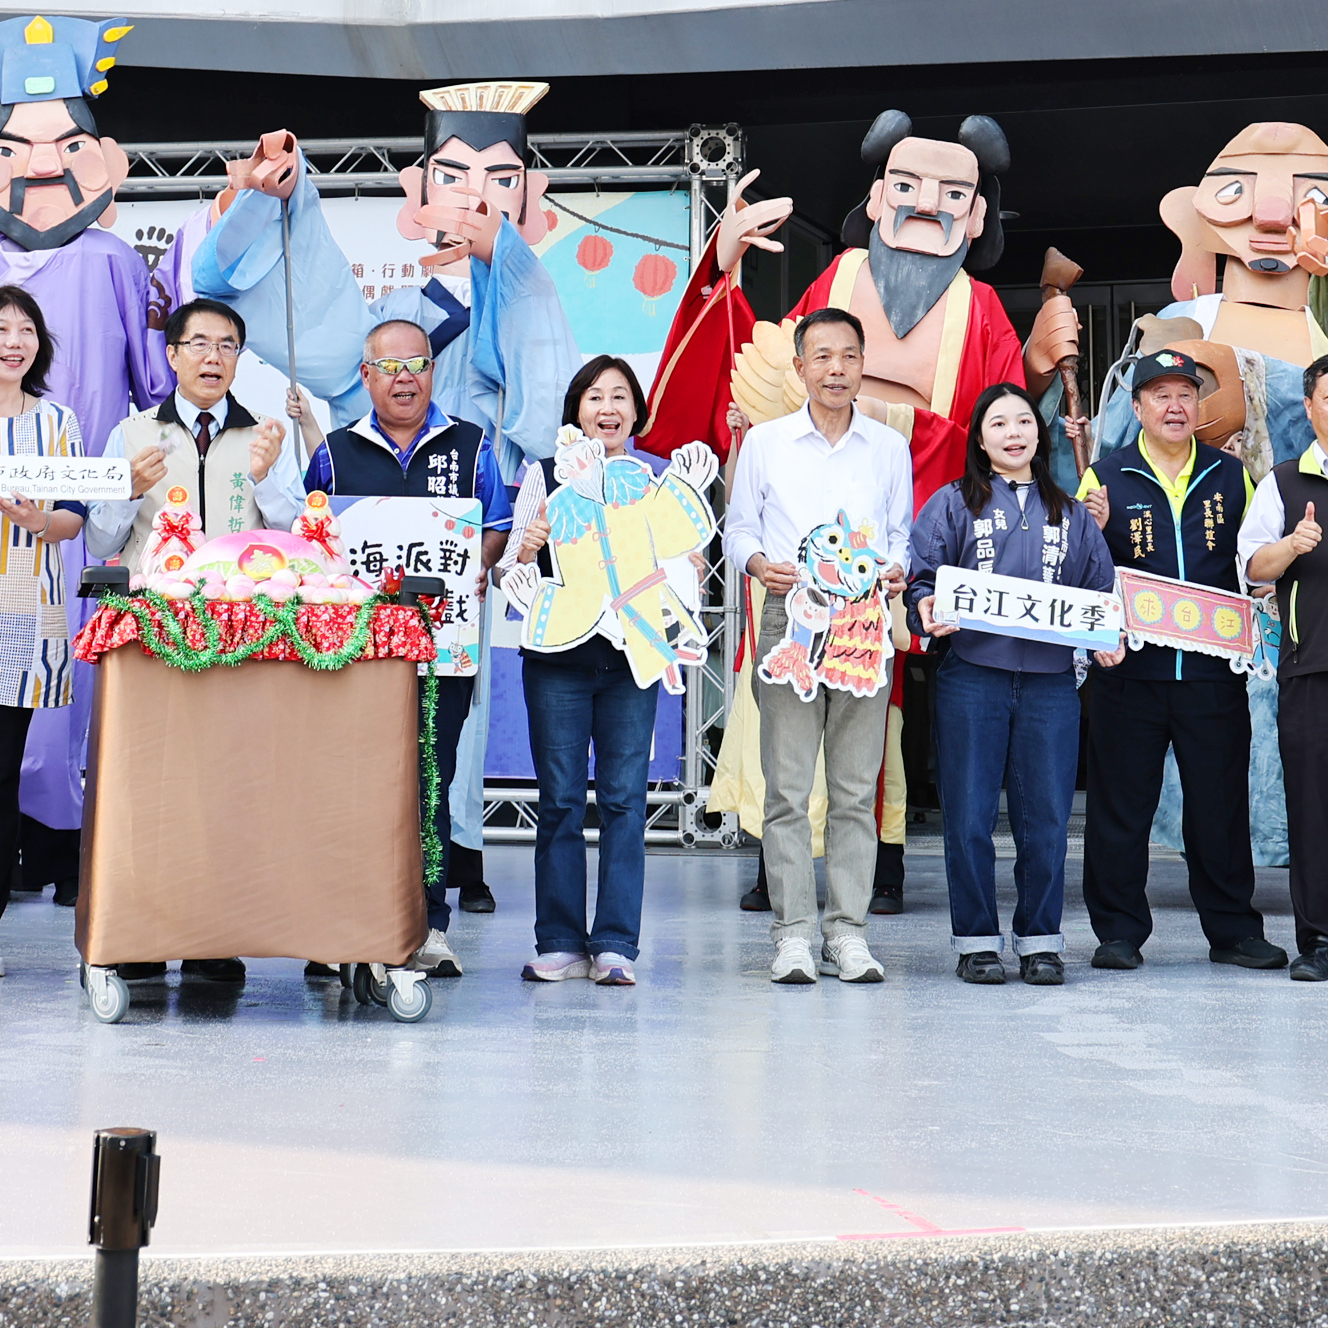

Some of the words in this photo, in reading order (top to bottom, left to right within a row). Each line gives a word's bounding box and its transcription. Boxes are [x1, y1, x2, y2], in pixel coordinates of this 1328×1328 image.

[60, 484, 76, 494] City
[79, 485, 126, 494] Government
[427, 454, 448, 498] 邱昭
[448, 448, 460, 498] 台南市議
[228, 472, 247, 533] 黃偉哲
[993, 508, 1008, 530] 女兒
[1213, 492, 1225, 524] 安南區
[1129, 517, 1146, 559] 劉澤民
[1203, 500, 1216, 551] 里長聯誼會
[349, 540, 471, 577] 海派對
[952, 583, 1106, 632] 台江文化季
